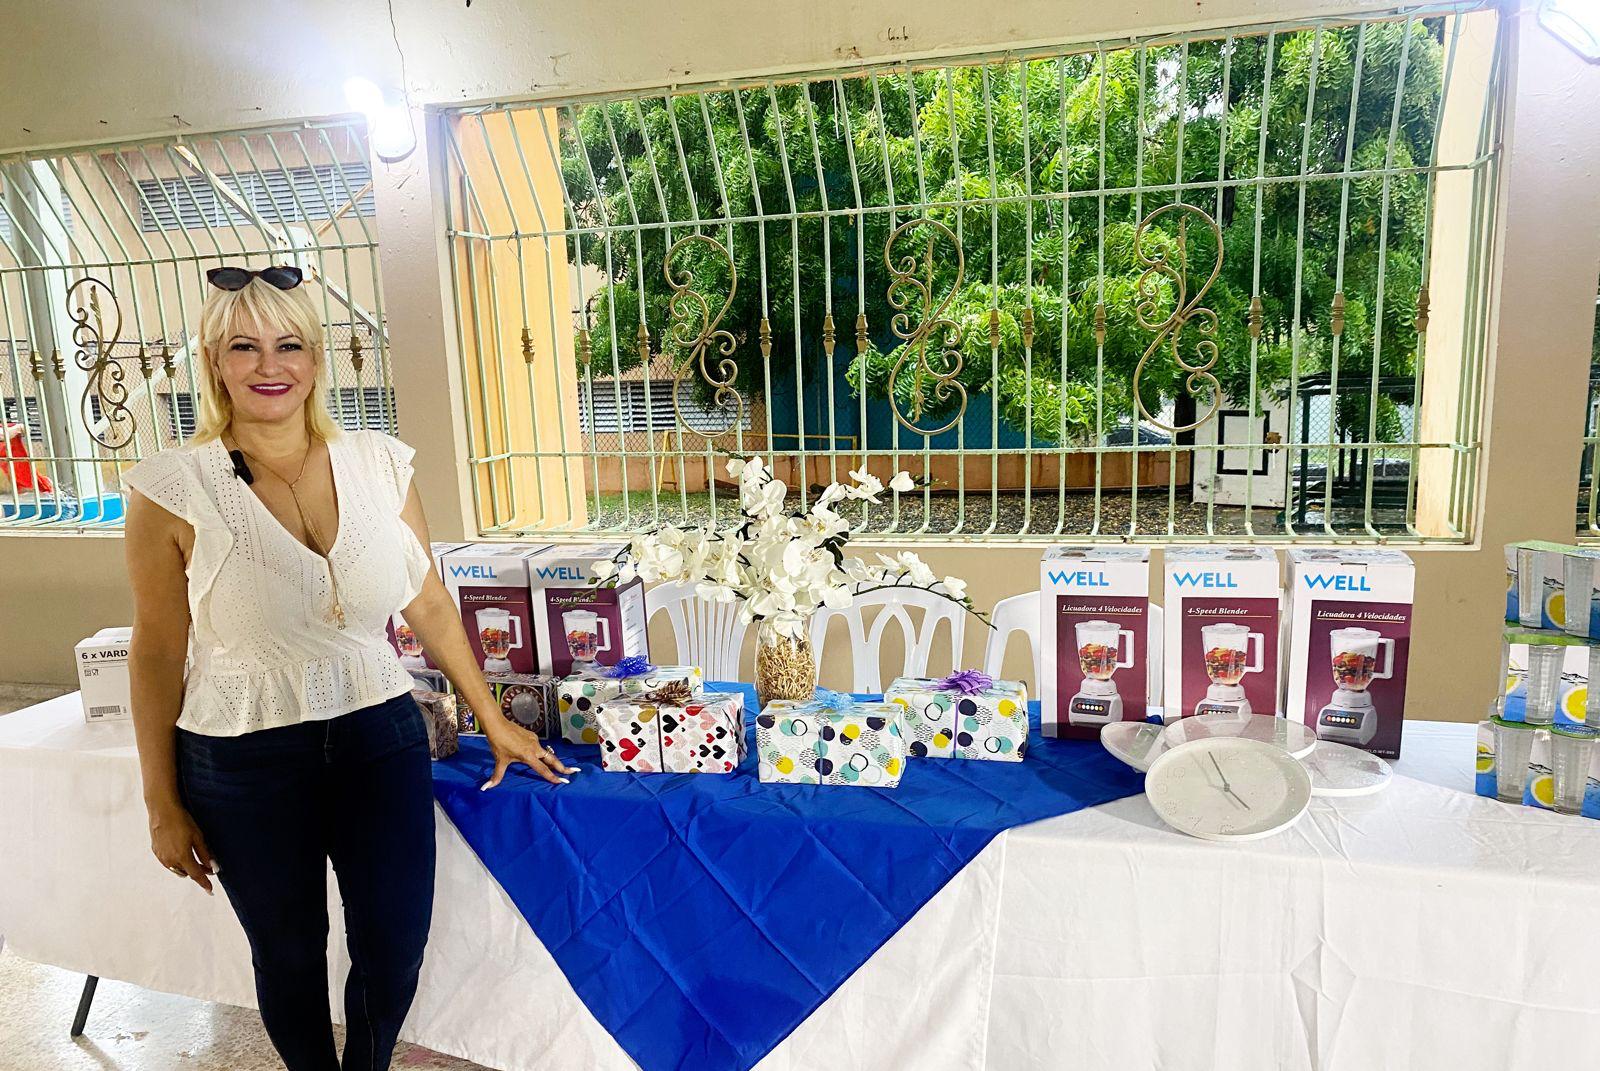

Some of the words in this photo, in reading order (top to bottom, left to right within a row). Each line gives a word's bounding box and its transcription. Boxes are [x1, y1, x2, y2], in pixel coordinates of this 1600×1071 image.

[450, 566, 497, 579] WELL
[536, 567, 585, 580] WELL
[1048, 570, 1109, 586] WELL
[1173, 572, 1238, 588] WELL
[1304, 574, 1371, 592] WELL
[463, 594, 485, 603] 4-Speed
[1062, 604, 1097, 612] Licuadora
[1104, 605, 1142, 613] Velocidades
[1187, 607, 1217, 616] 4-Speed
[1218, 607, 1248, 615] Blender
[1317, 610, 1355, 619] Licuadora
[1356, 611, 1363, 619] 4
[1363, 612, 1407, 621] Velocidades
[82, 652, 88, 660] 6
[99, 649, 128, 658] VARD
